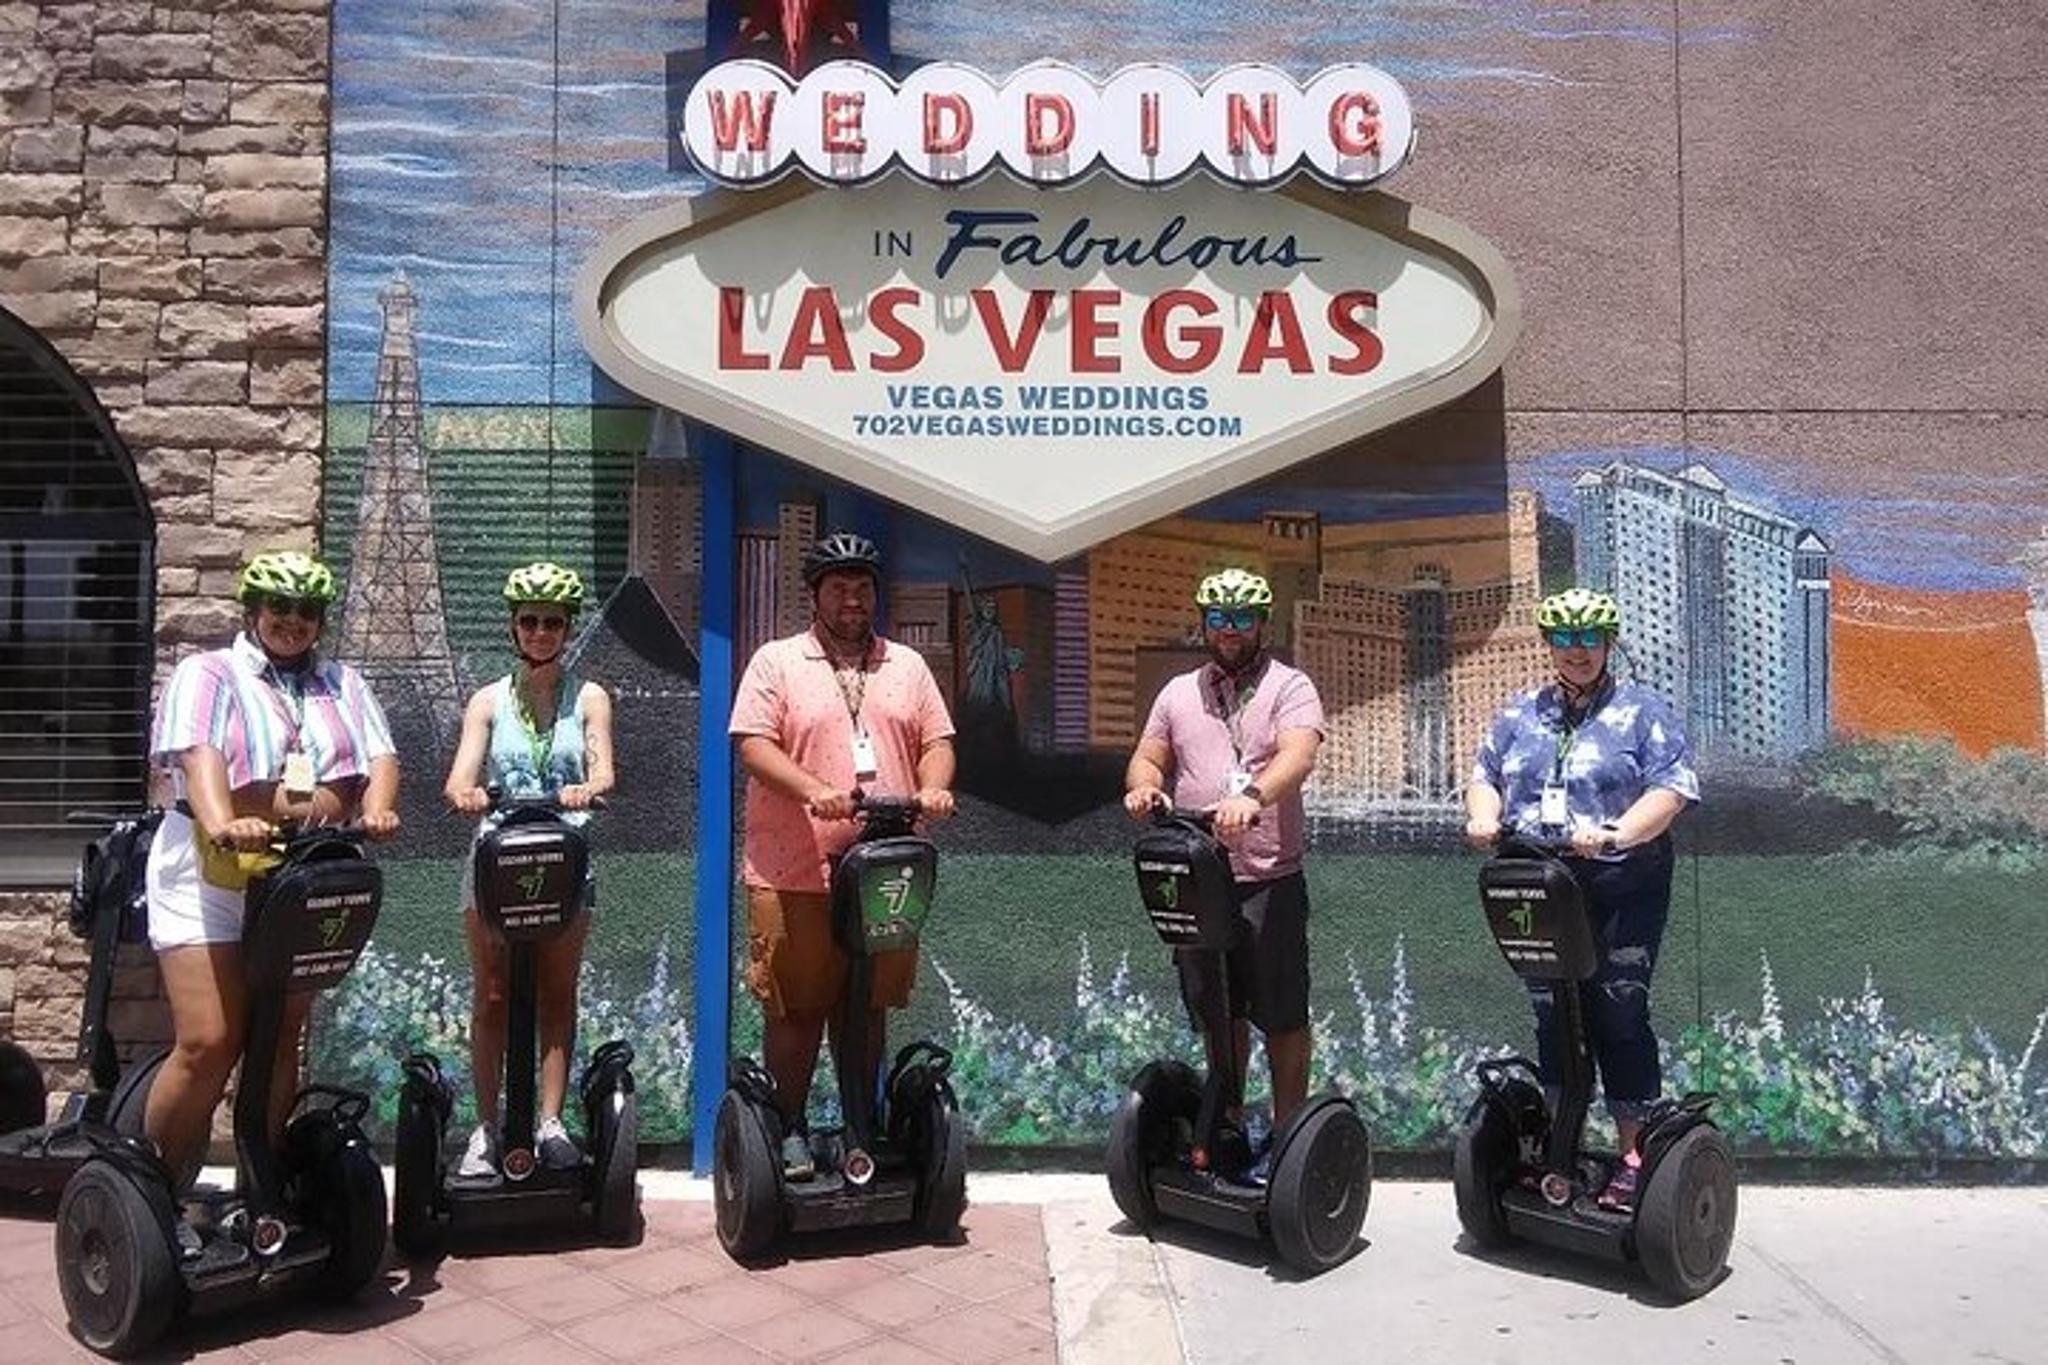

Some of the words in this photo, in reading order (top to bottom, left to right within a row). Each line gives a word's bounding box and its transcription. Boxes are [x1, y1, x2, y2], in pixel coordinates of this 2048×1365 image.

[706, 90, 1383, 156] WEDDING
[872, 230, 912, 258] IN
[934, 210, 1321, 279] Fabulous
[717, 287, 926, 374] LAS
[971, 288, 1385, 375] VEGAS
[852, 413, 1243, 438] 702VEGASWEDDINGS.COM
[886, 385, 1005, 411] VEGAS
[1018, 385, 1209, 411] WEDDINGS
